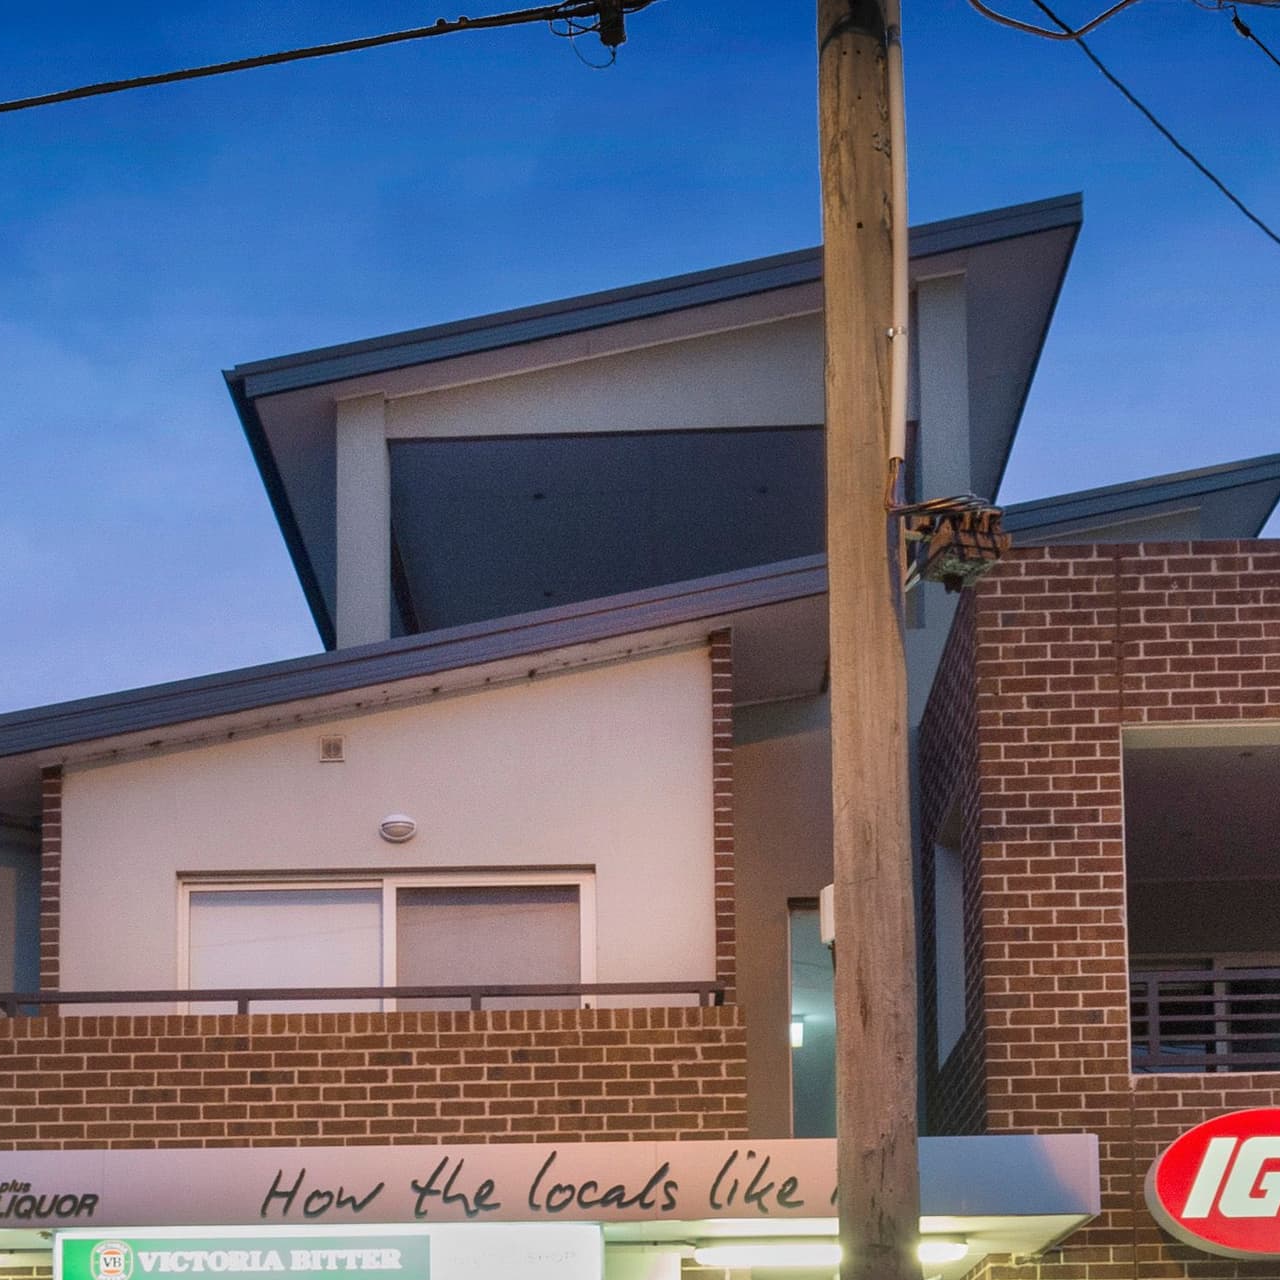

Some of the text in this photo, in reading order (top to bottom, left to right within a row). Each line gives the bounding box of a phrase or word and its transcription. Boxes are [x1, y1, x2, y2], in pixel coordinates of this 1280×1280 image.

[259, 1148, 806, 1219] How the locals like
[138, 1248, 286, 1275] VICTORIA
[289, 1247, 403, 1271] BITTER
